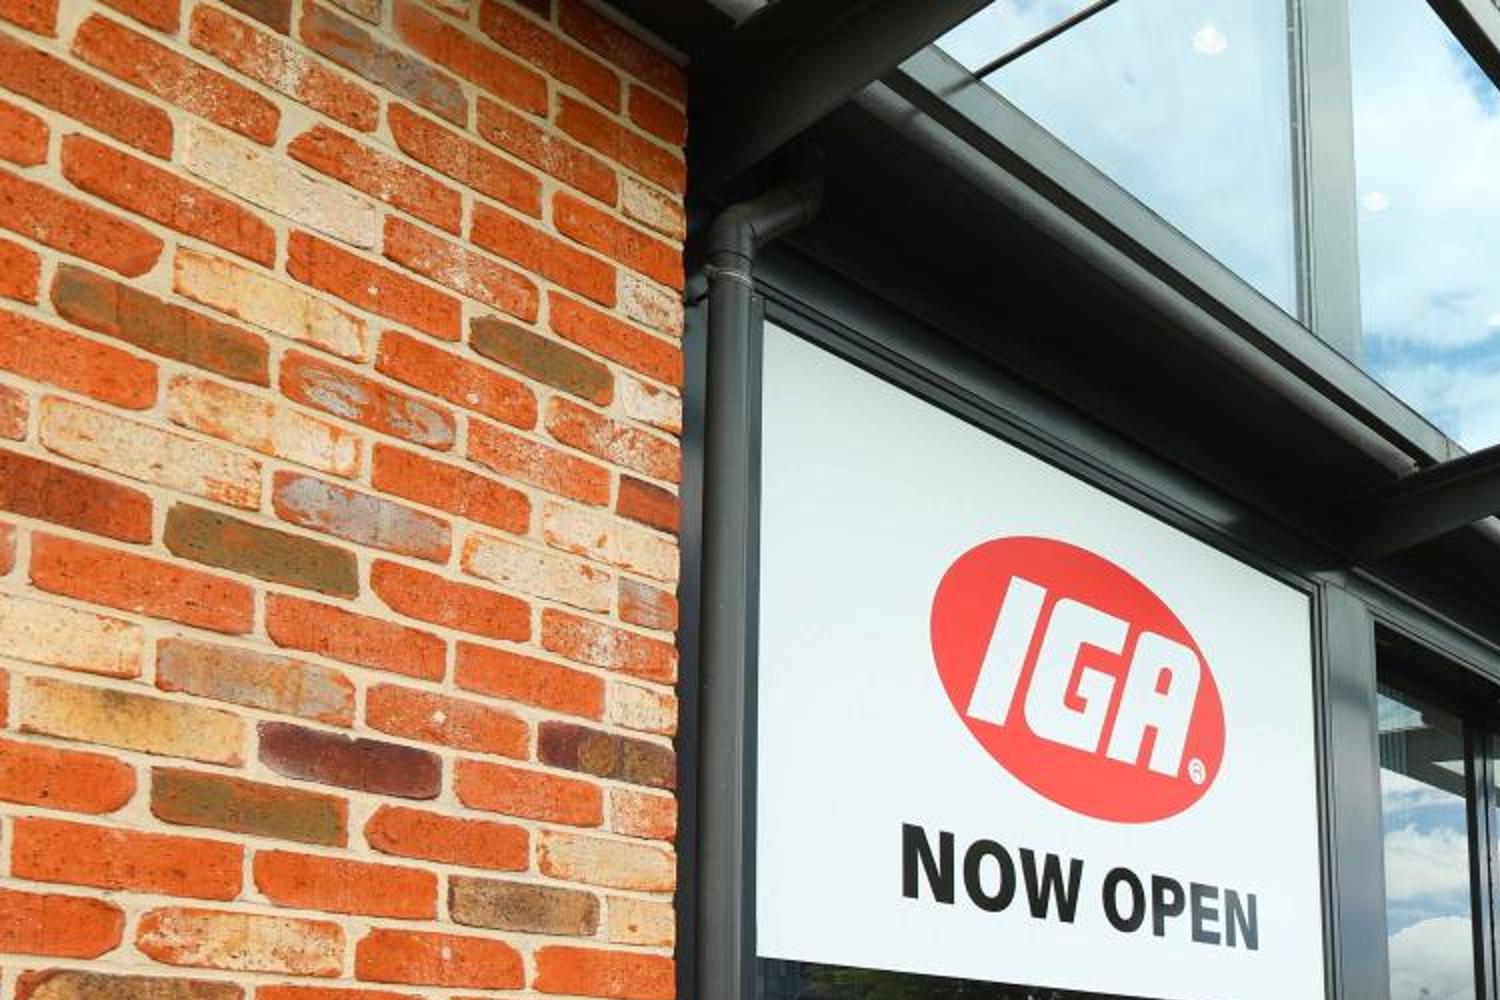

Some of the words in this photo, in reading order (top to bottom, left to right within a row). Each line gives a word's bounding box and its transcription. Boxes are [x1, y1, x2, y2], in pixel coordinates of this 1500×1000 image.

[966, 575, 1202, 778] IGA
[902, 823, 1084, 924] NOW
[1102, 866, 1260, 951] OPEN
